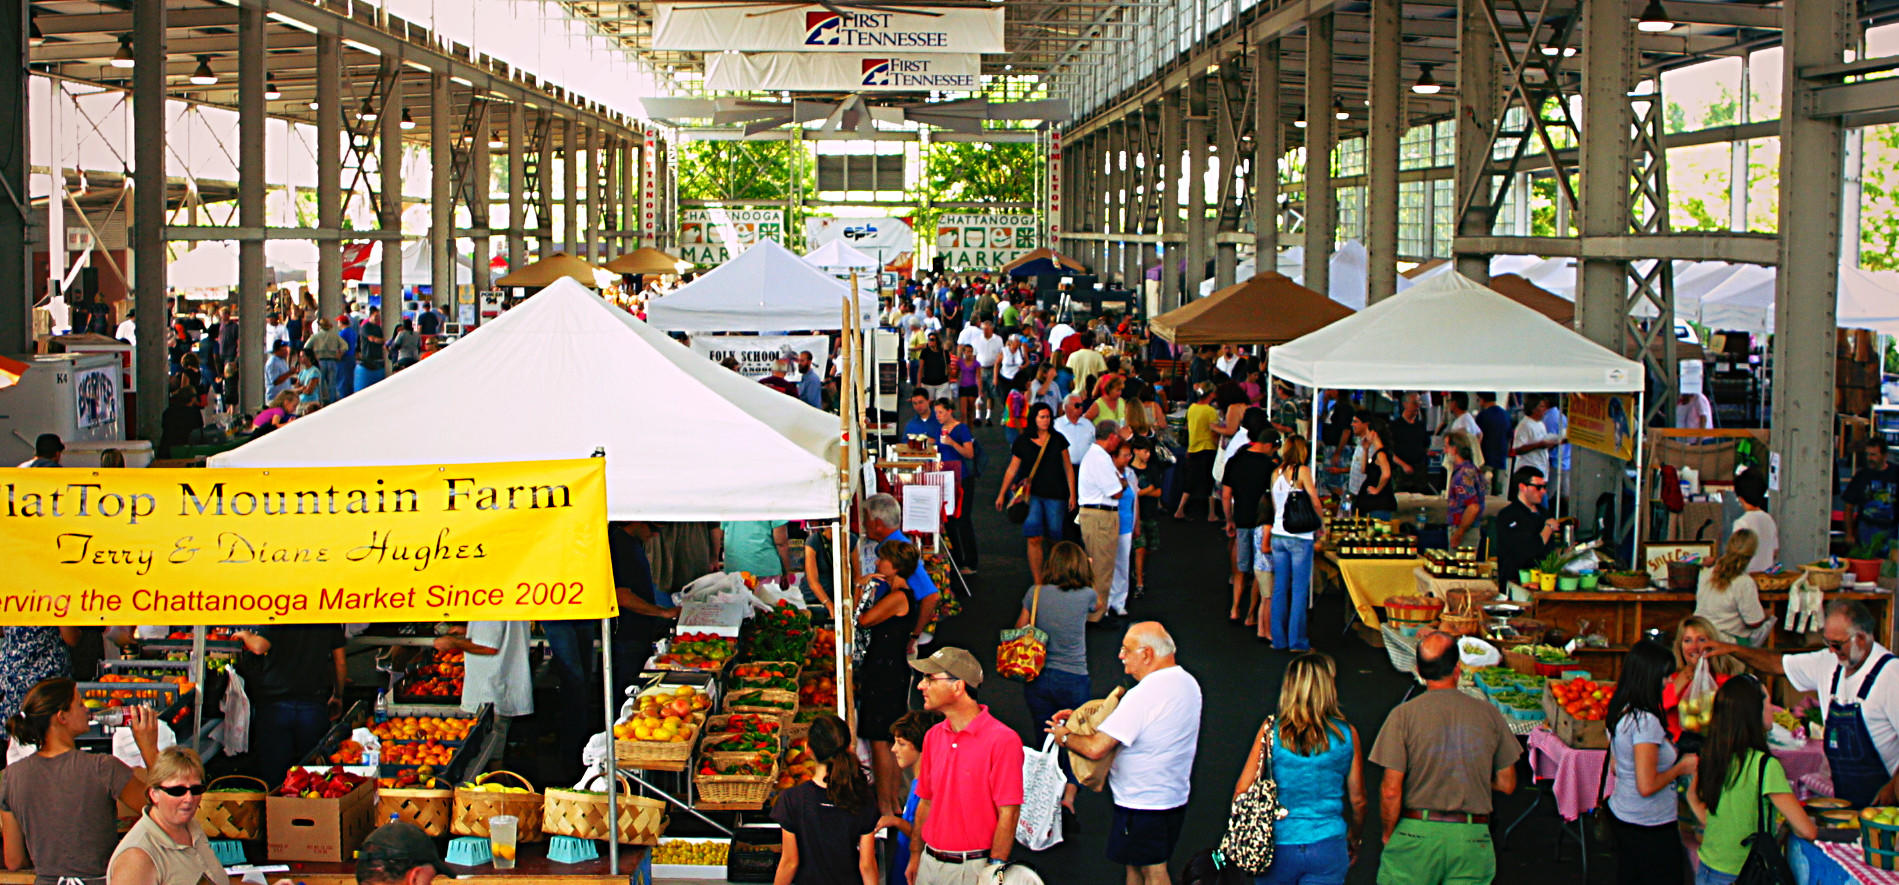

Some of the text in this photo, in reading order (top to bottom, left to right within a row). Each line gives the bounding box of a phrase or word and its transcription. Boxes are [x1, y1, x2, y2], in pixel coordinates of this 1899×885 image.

[842, 12, 893, 28] FIRST
[841, 29, 948, 46] TENNESSEE
[890, 58, 931, 72] FIRST
[888, 73, 973, 86] TENNESSEE
[1051, 132, 1061, 212] HAMILTON
[645, 130, 654, 240] CHATTANOOGA
[682, 210, 780, 221] CHANOOGA
[938, 251, 1028, 266] MARKE
[0, 477, 574, 524] latTop Mountain Farm
[57, 527, 488, 575] Terry & Diane Hughes
[0, 581, 584, 618] rving the Chattanooga Market Since 2002
